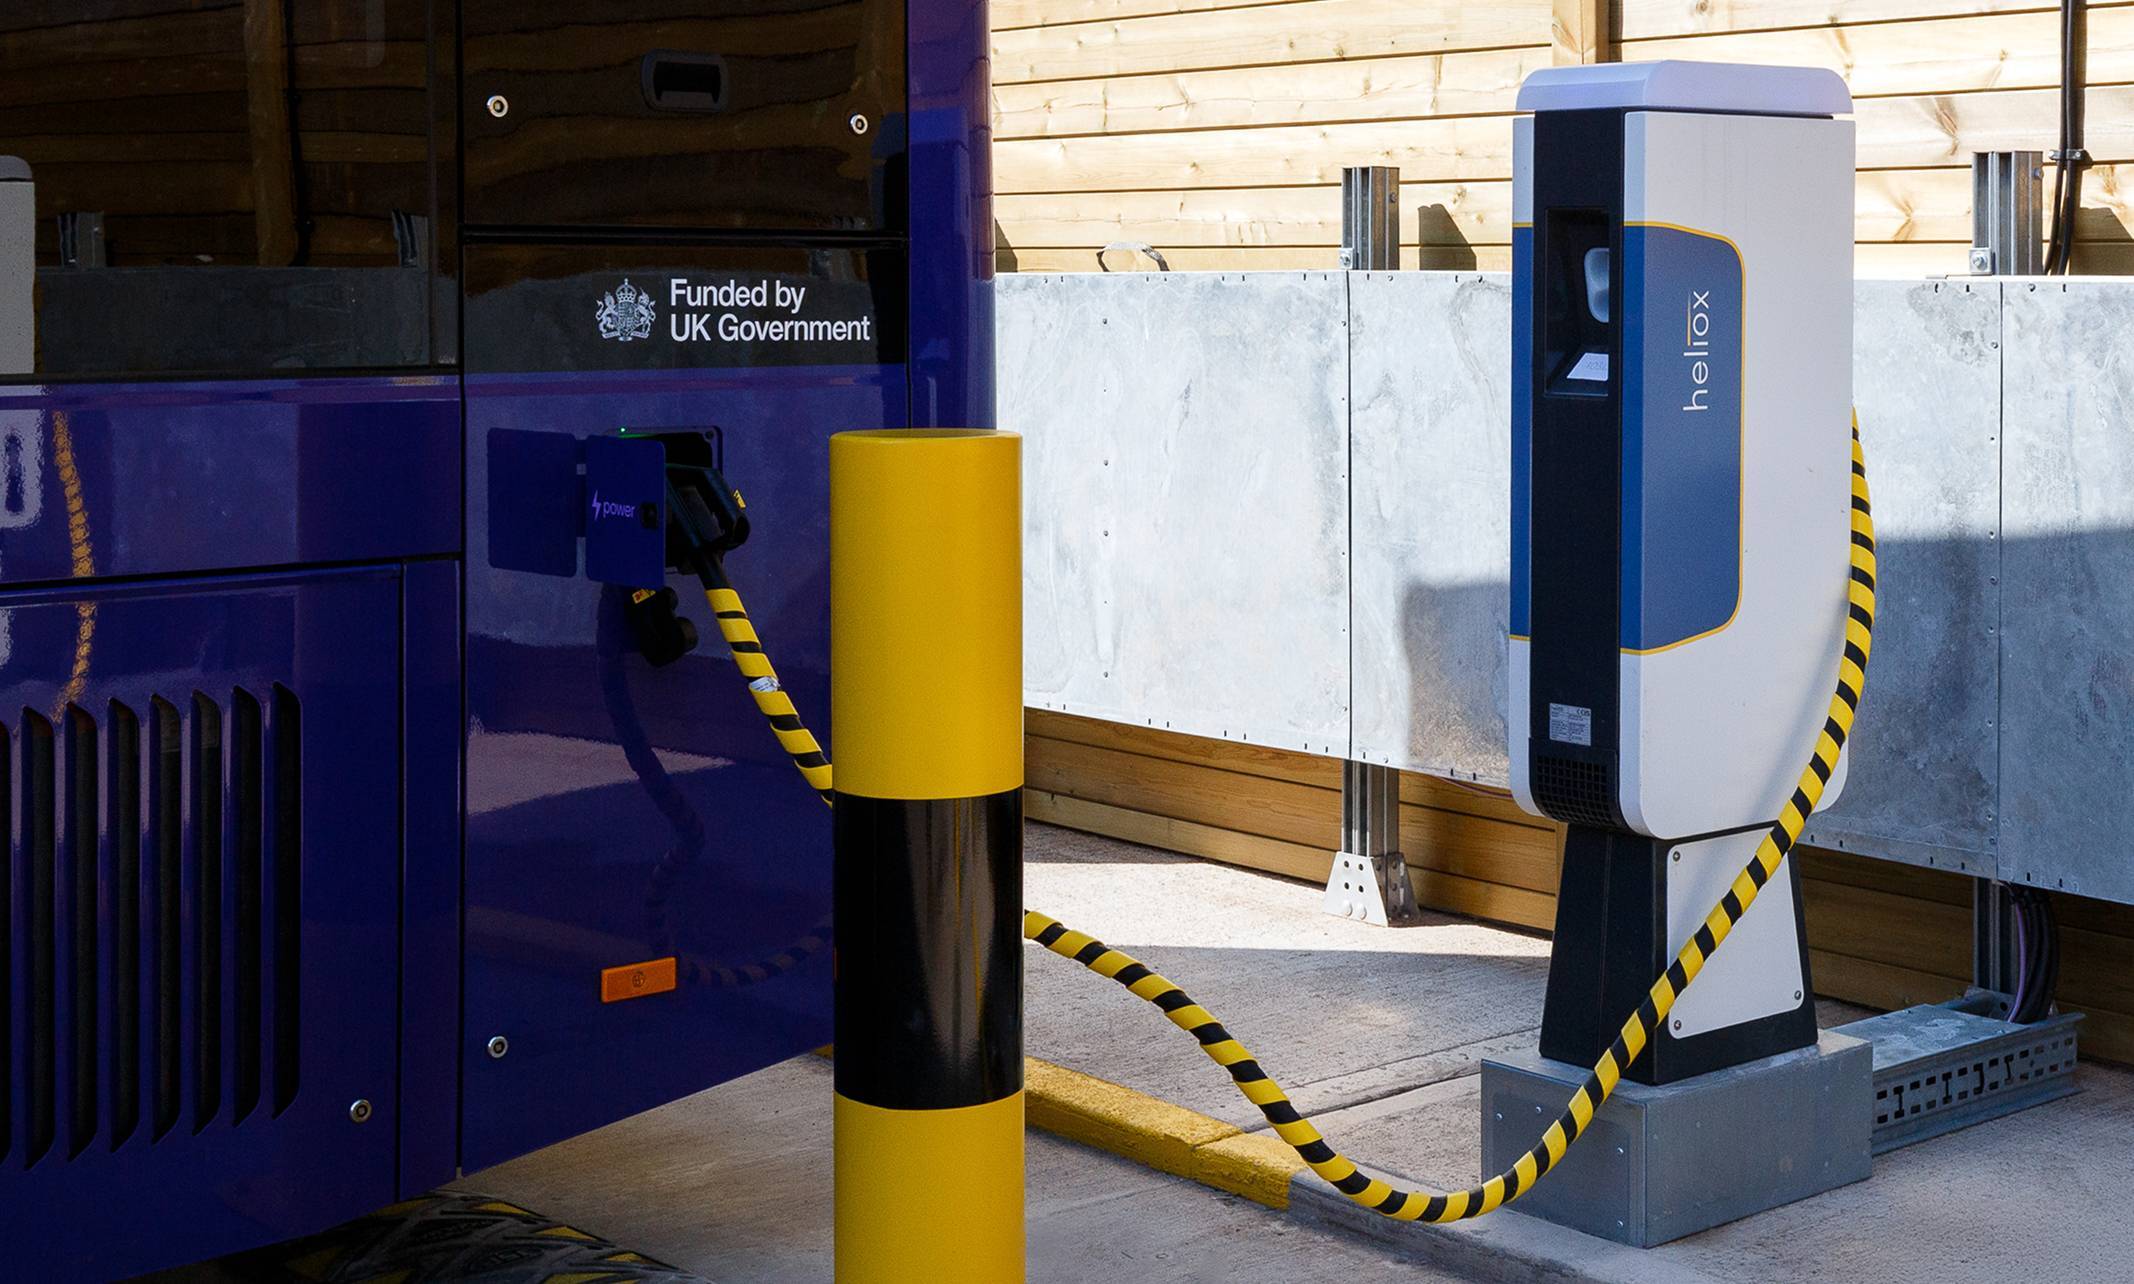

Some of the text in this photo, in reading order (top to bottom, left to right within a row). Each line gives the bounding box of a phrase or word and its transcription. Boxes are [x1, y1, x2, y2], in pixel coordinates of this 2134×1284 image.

[670, 278, 806, 314] Funded by
[670, 313, 871, 342] UK Government
[1683, 290, 1709, 411] heliox
[603, 501, 635, 519] power
